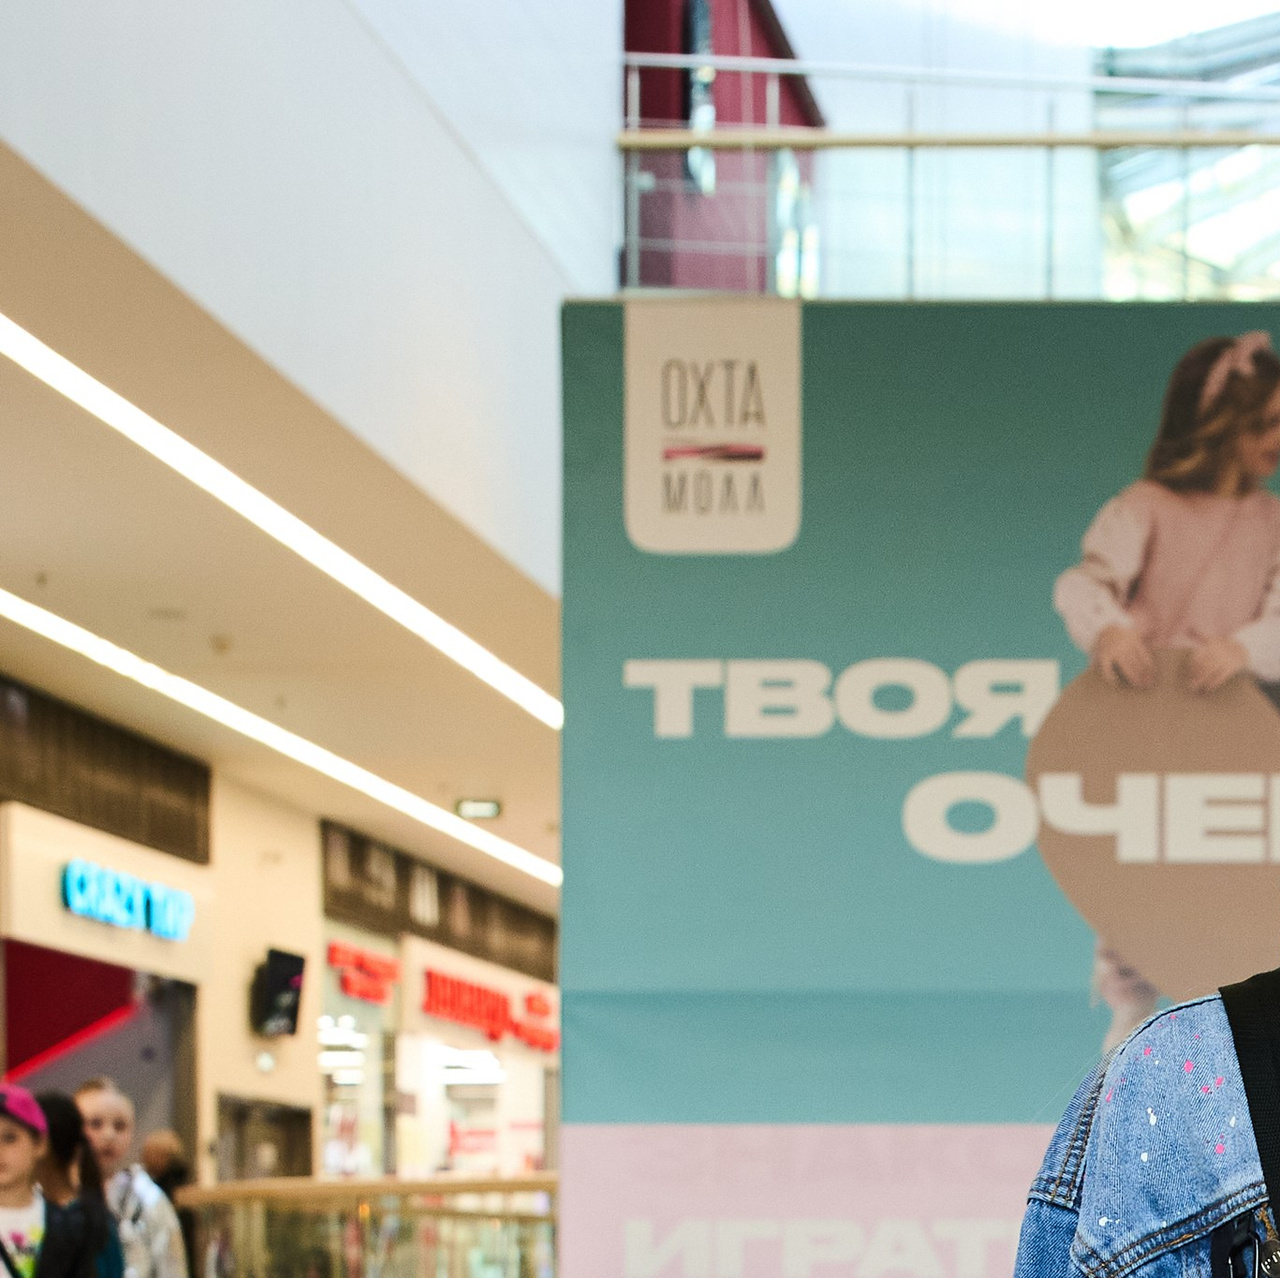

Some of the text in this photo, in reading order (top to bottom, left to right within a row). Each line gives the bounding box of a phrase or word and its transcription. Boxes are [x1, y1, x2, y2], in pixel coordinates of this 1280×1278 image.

[661, 357, 766, 429] ОХТА
[661, 469, 766, 515] МОЛЛ
[623, 657, 1060, 740] ТВОЯ
